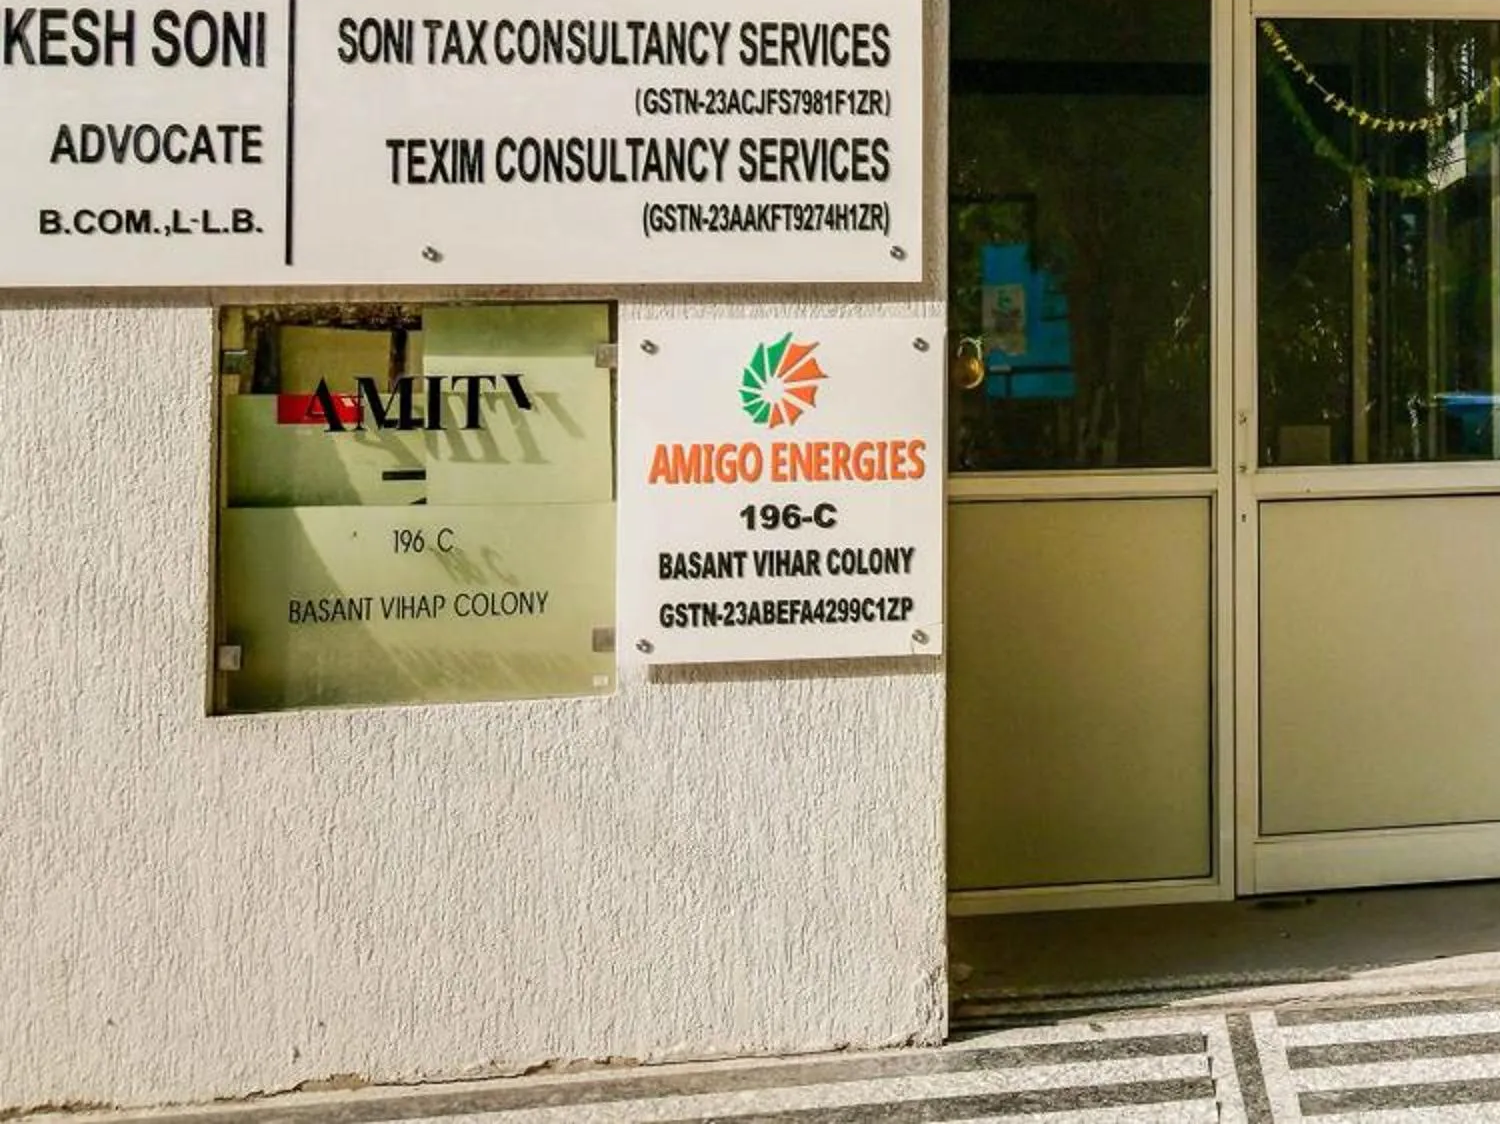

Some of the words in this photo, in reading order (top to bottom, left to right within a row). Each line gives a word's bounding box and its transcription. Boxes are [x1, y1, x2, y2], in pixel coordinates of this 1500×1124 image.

[3, 7, 135, 67] KESH
[151, 9, 267, 68] SONI
[337, 17, 414, 65] SONI
[423, 20, 488, 65] TAX
[493, 19, 732, 67] CONSULTANCY
[738, 21, 892, 68] SERVICES
[49, 123, 263, 164] ADVOCATE
[385, 138, 485, 185] TEXIM
[498, 136, 731, 184] CONSULTANCY
[738, 137, 891, 183] SERVICES
[648, 442, 764, 485] AMIGO
[770, 439, 927, 483] ENERGIES
[739, 502, 838, 531] 196-C
[393, 528, 425, 554] 196
[437, 527, 454, 553] C
[658, 551, 748, 580] BASANT
[753, 549, 821, 577] VIHAR
[826, 546, 915, 575] COLONY
[288, 596, 374, 624] BASANT
[453, 590, 549, 617] COLONY
